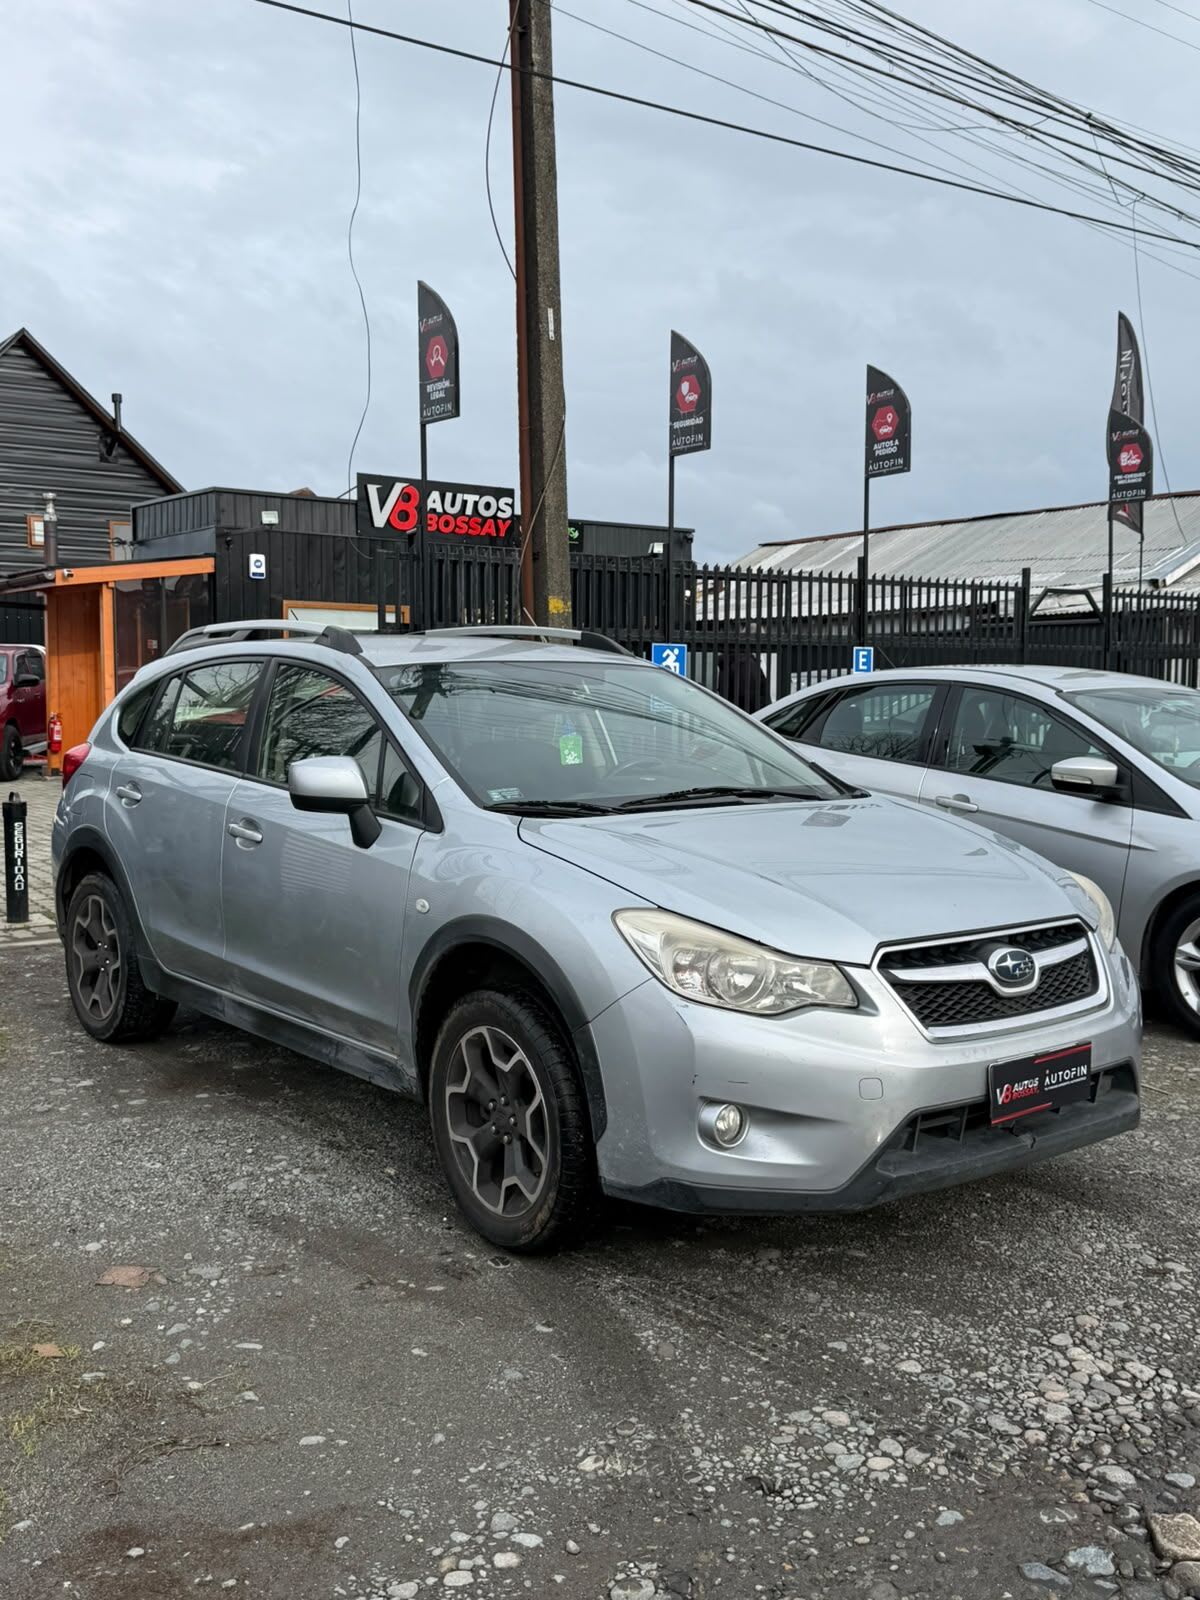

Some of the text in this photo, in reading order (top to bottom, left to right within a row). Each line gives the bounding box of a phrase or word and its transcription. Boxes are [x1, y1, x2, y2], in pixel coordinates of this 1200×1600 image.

[423, 402, 452, 417] AUTOFIN
[672, 433, 704, 447] AUTOFIN
[873, 440, 894, 451] AUTOS
[875, 446, 898, 457] PEDIDO
[869, 457, 904, 471] AUTOFIN
[1111, 488, 1146, 499] AUTOFIN
[366, 482, 513, 531] V8 AUTOS
[427, 513, 512, 537] BOSSAY
[859, 651, 868, 670] E
[14, 821, 25, 891] SEGURIDAD
[1044, 1064, 1088, 1087] AUTOFIN
[996, 1077, 1040, 1105] V8 AUTOS
